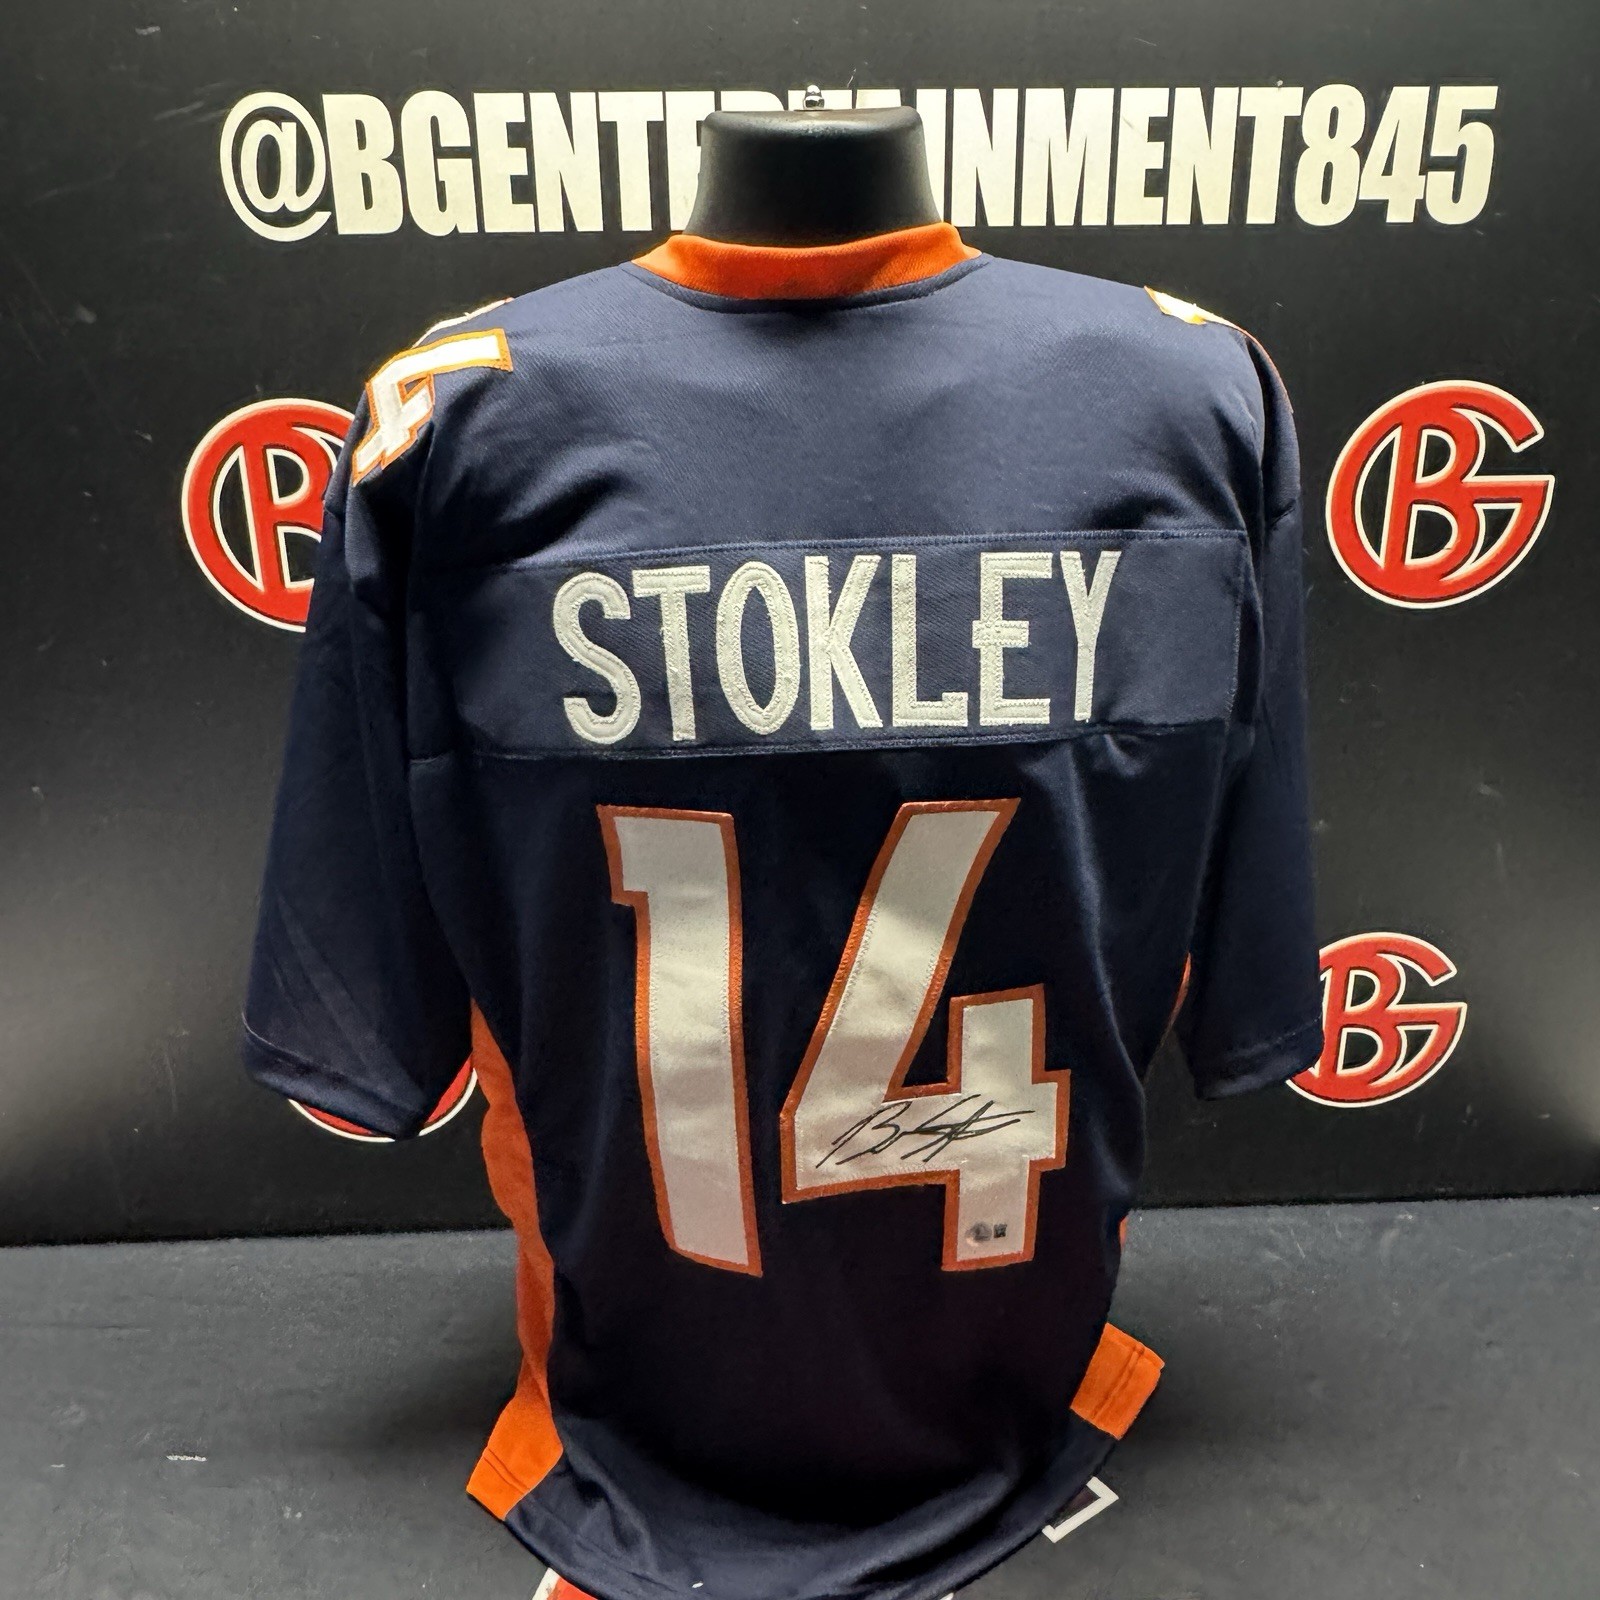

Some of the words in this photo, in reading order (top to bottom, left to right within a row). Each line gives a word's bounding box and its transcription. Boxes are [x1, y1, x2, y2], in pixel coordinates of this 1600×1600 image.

[220, 84, 1498, 242] @BGENTEINMENT845
[1325, 379, 1555, 609] BG
[552, 550, 1122, 745] STOKLEY
[596, 797, 1071, 1278] 14
